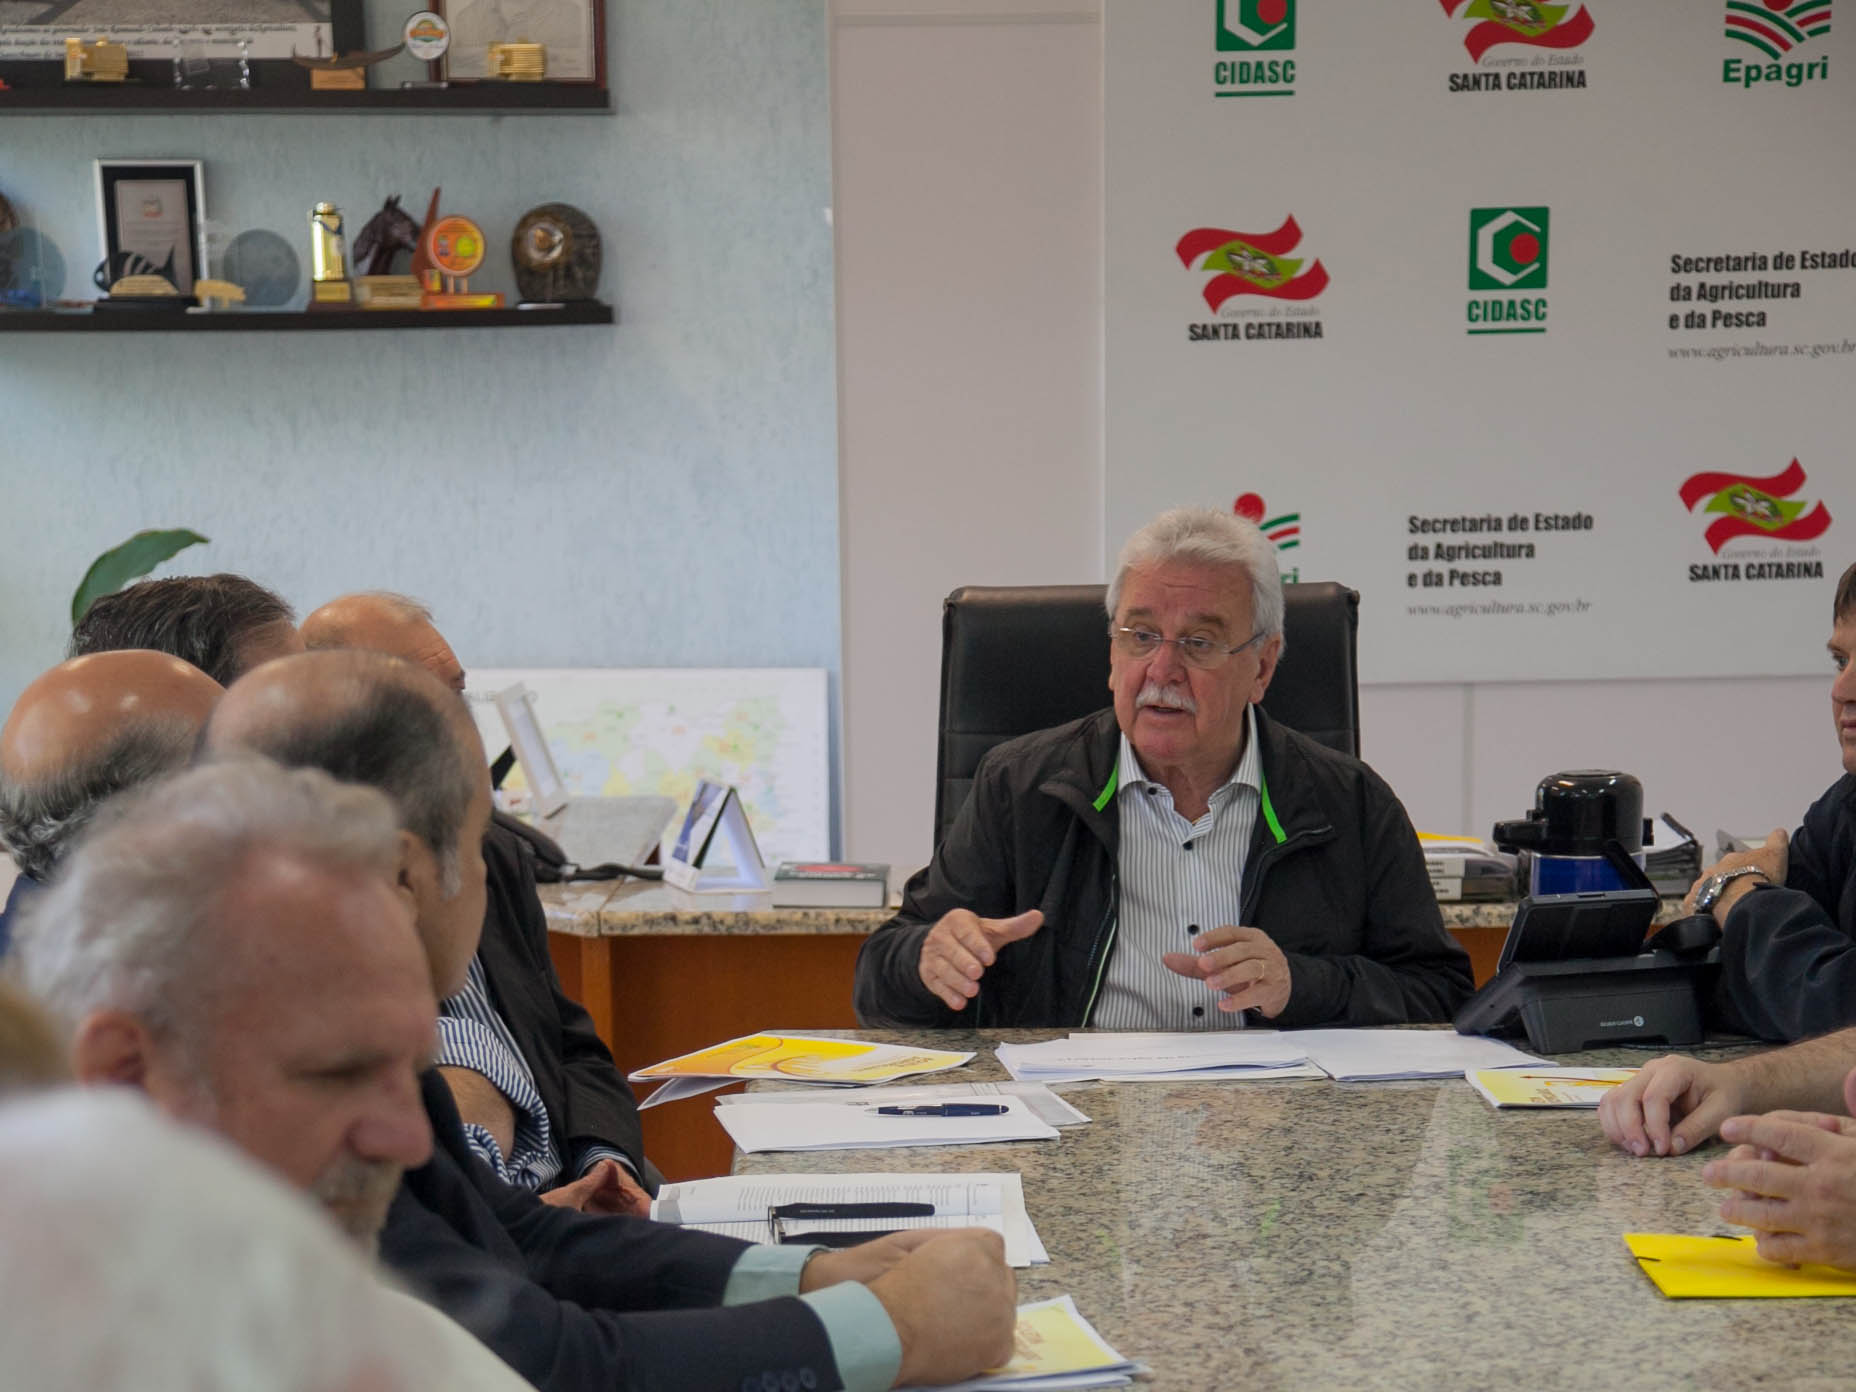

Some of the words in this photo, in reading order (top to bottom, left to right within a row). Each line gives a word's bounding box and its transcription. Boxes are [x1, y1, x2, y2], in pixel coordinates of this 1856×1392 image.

[1214, 60, 1296, 85] CIDASC
[1448, 72, 1502, 92] SANTA
[1506, 69, 1587, 91] CATARINA
[1722, 55, 1829, 89] Epagri
[1671, 252, 1768, 273] Secretaria
[1773, 250, 1796, 271] de
[1669, 282, 1692, 301] da
[1696, 280, 1801, 303] Agricultura
[1467, 297, 1548, 322] CIDASC
[1668, 312, 1680, 330] e
[1684, 309, 1707, 330] da
[1711, 308, 1767, 328] Pesca
[1188, 322, 1241, 342] SANTA
[1245, 320, 1324, 340] CATARINA
[1408, 514, 1503, 534] Secretaria
[1507, 513, 1530, 532] de
[1534, 511, 1594, 531] Estado
[1407, 542, 1430, 561] da
[1433, 540, 1536, 563] Agricultura
[1407, 571, 1418, 588] e
[1422, 569, 1444, 588] da
[1449, 568, 1503, 587] Pesca
[1688, 563, 1741, 582] SANTA
[1745, 561, 1825, 581] CATARINA
